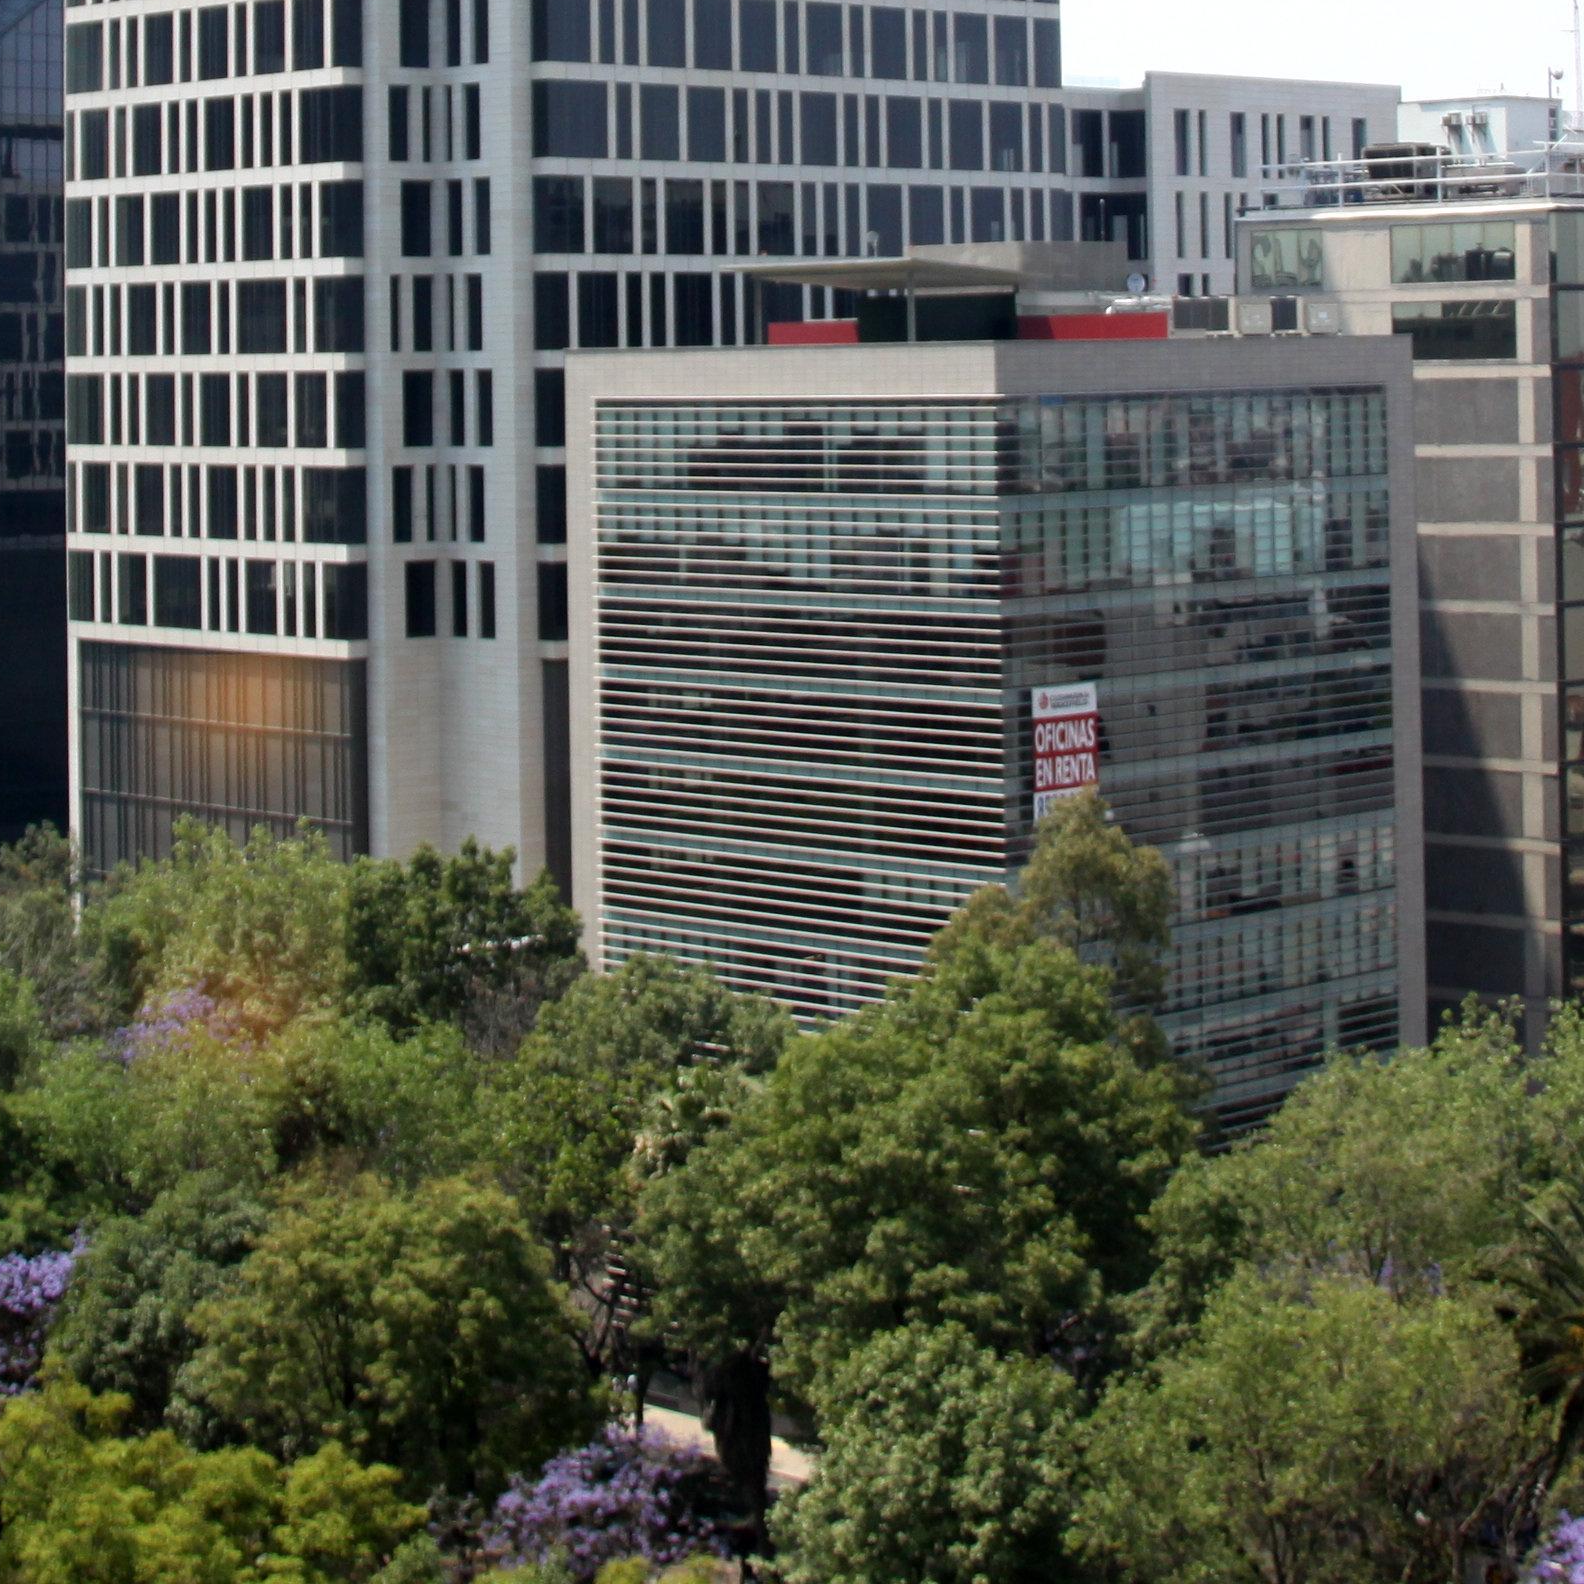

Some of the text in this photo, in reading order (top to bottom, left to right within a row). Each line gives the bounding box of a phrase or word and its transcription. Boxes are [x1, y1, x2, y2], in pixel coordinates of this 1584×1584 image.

[1035, 718, 1095, 753] OFICINAS
[1036, 752, 1096, 787] EN RENTA
